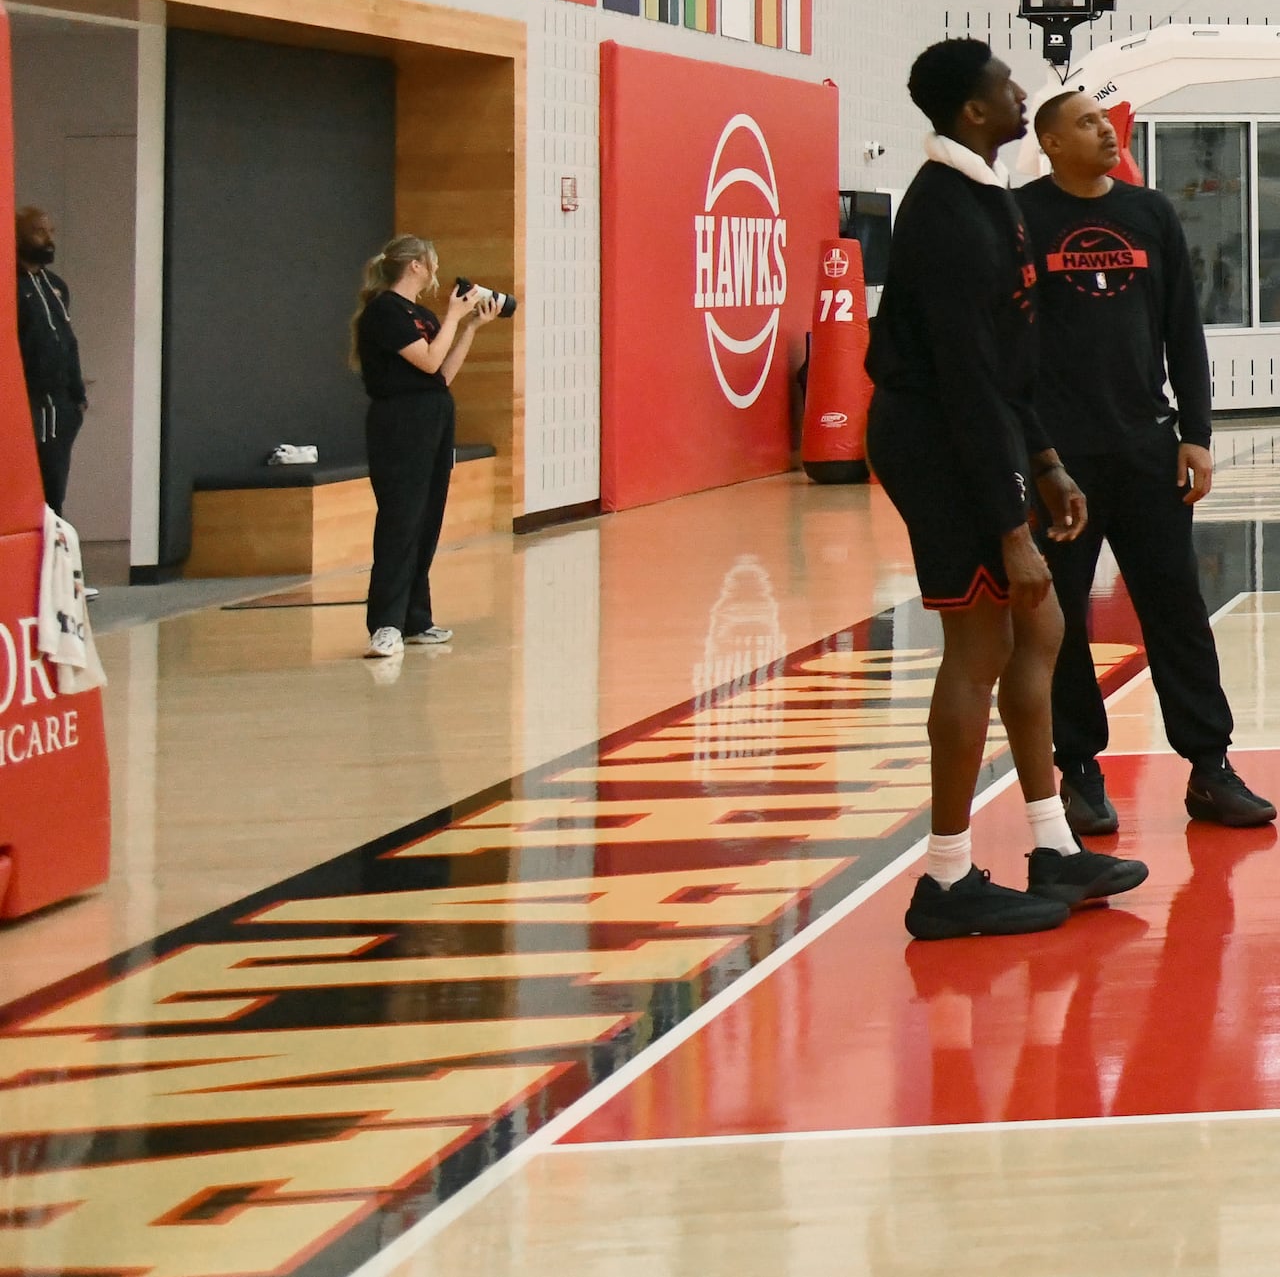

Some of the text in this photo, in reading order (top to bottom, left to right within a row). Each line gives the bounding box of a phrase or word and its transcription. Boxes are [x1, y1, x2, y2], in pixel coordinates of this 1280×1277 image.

[694, 215, 788, 309] HAWKS
[1062, 252, 1135, 269] HAWKS
[819, 289, 854, 323] 72
